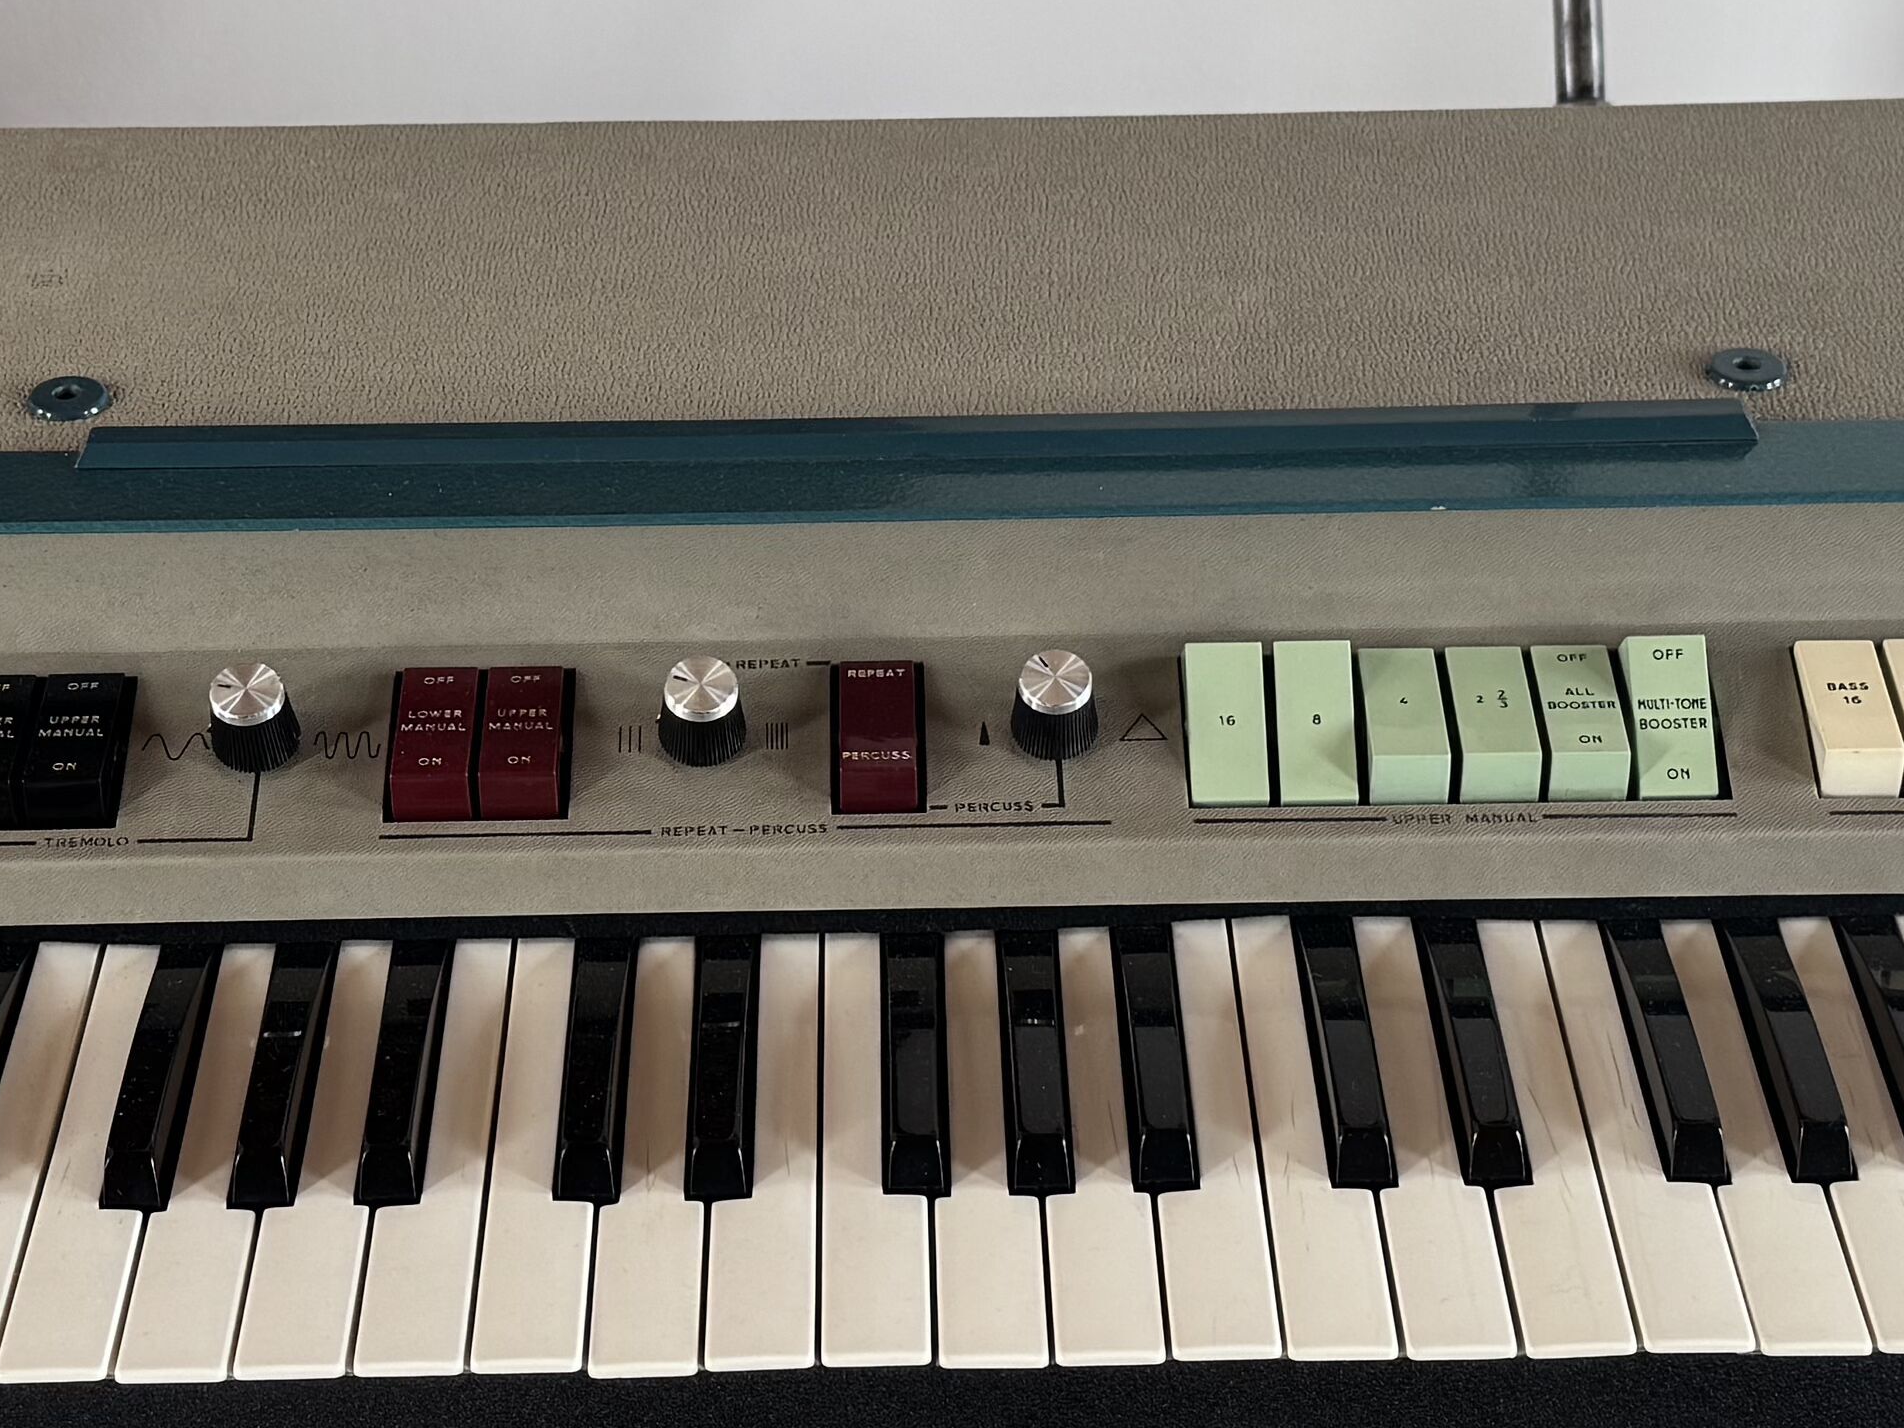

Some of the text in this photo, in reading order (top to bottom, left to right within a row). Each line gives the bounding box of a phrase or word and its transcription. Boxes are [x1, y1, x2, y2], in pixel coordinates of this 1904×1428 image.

[1557, 653, 1587, 664] OFF
[1652, 648, 1684, 661] OFF
[736, 658, 801, 670] REPEAT
[847, 668, 906, 678] REPEAT
[424, 676, 455, 686] OFF
[511, 675, 541, 684] OFF
[67, 682, 99, 692] OFF
[1827, 681, 1869, 691] BASS
[1564, 687, 1595, 697] ALL
[1547, 700, 1617, 710] BOOSTER
[1637, 697, 1707, 711] MULTI-TONE
[1843, 695, 1862, 705] 16
[408, 709, 462, 719] LOWER
[497, 708, 547, 718] UPPER
[49, 714, 100, 725] UPPER
[1218, 714, 1236, 727] 16
[1312, 713, 1322, 726] 8
[1639, 717, 1708, 731] BOOSTER
[401, 722, 466, 732] MANUAL
[488, 721, 553, 731] MANUAL
[38, 727, 104, 738] MANUAL
[1578, 733, 1603, 744] ON
[418, 756, 442, 766] ON
[507, 755, 531, 765] ON
[52, 761, 77, 771] ON
[1666, 767, 1691, 780] ON
[955, 800, 1034, 813] PERCUSS
[1393, 810, 1538, 826] UPPER MANUAL
[660, 823, 828, 837] REPEAT PERCUSS
[44, 835, 129, 848] TREMOLO
